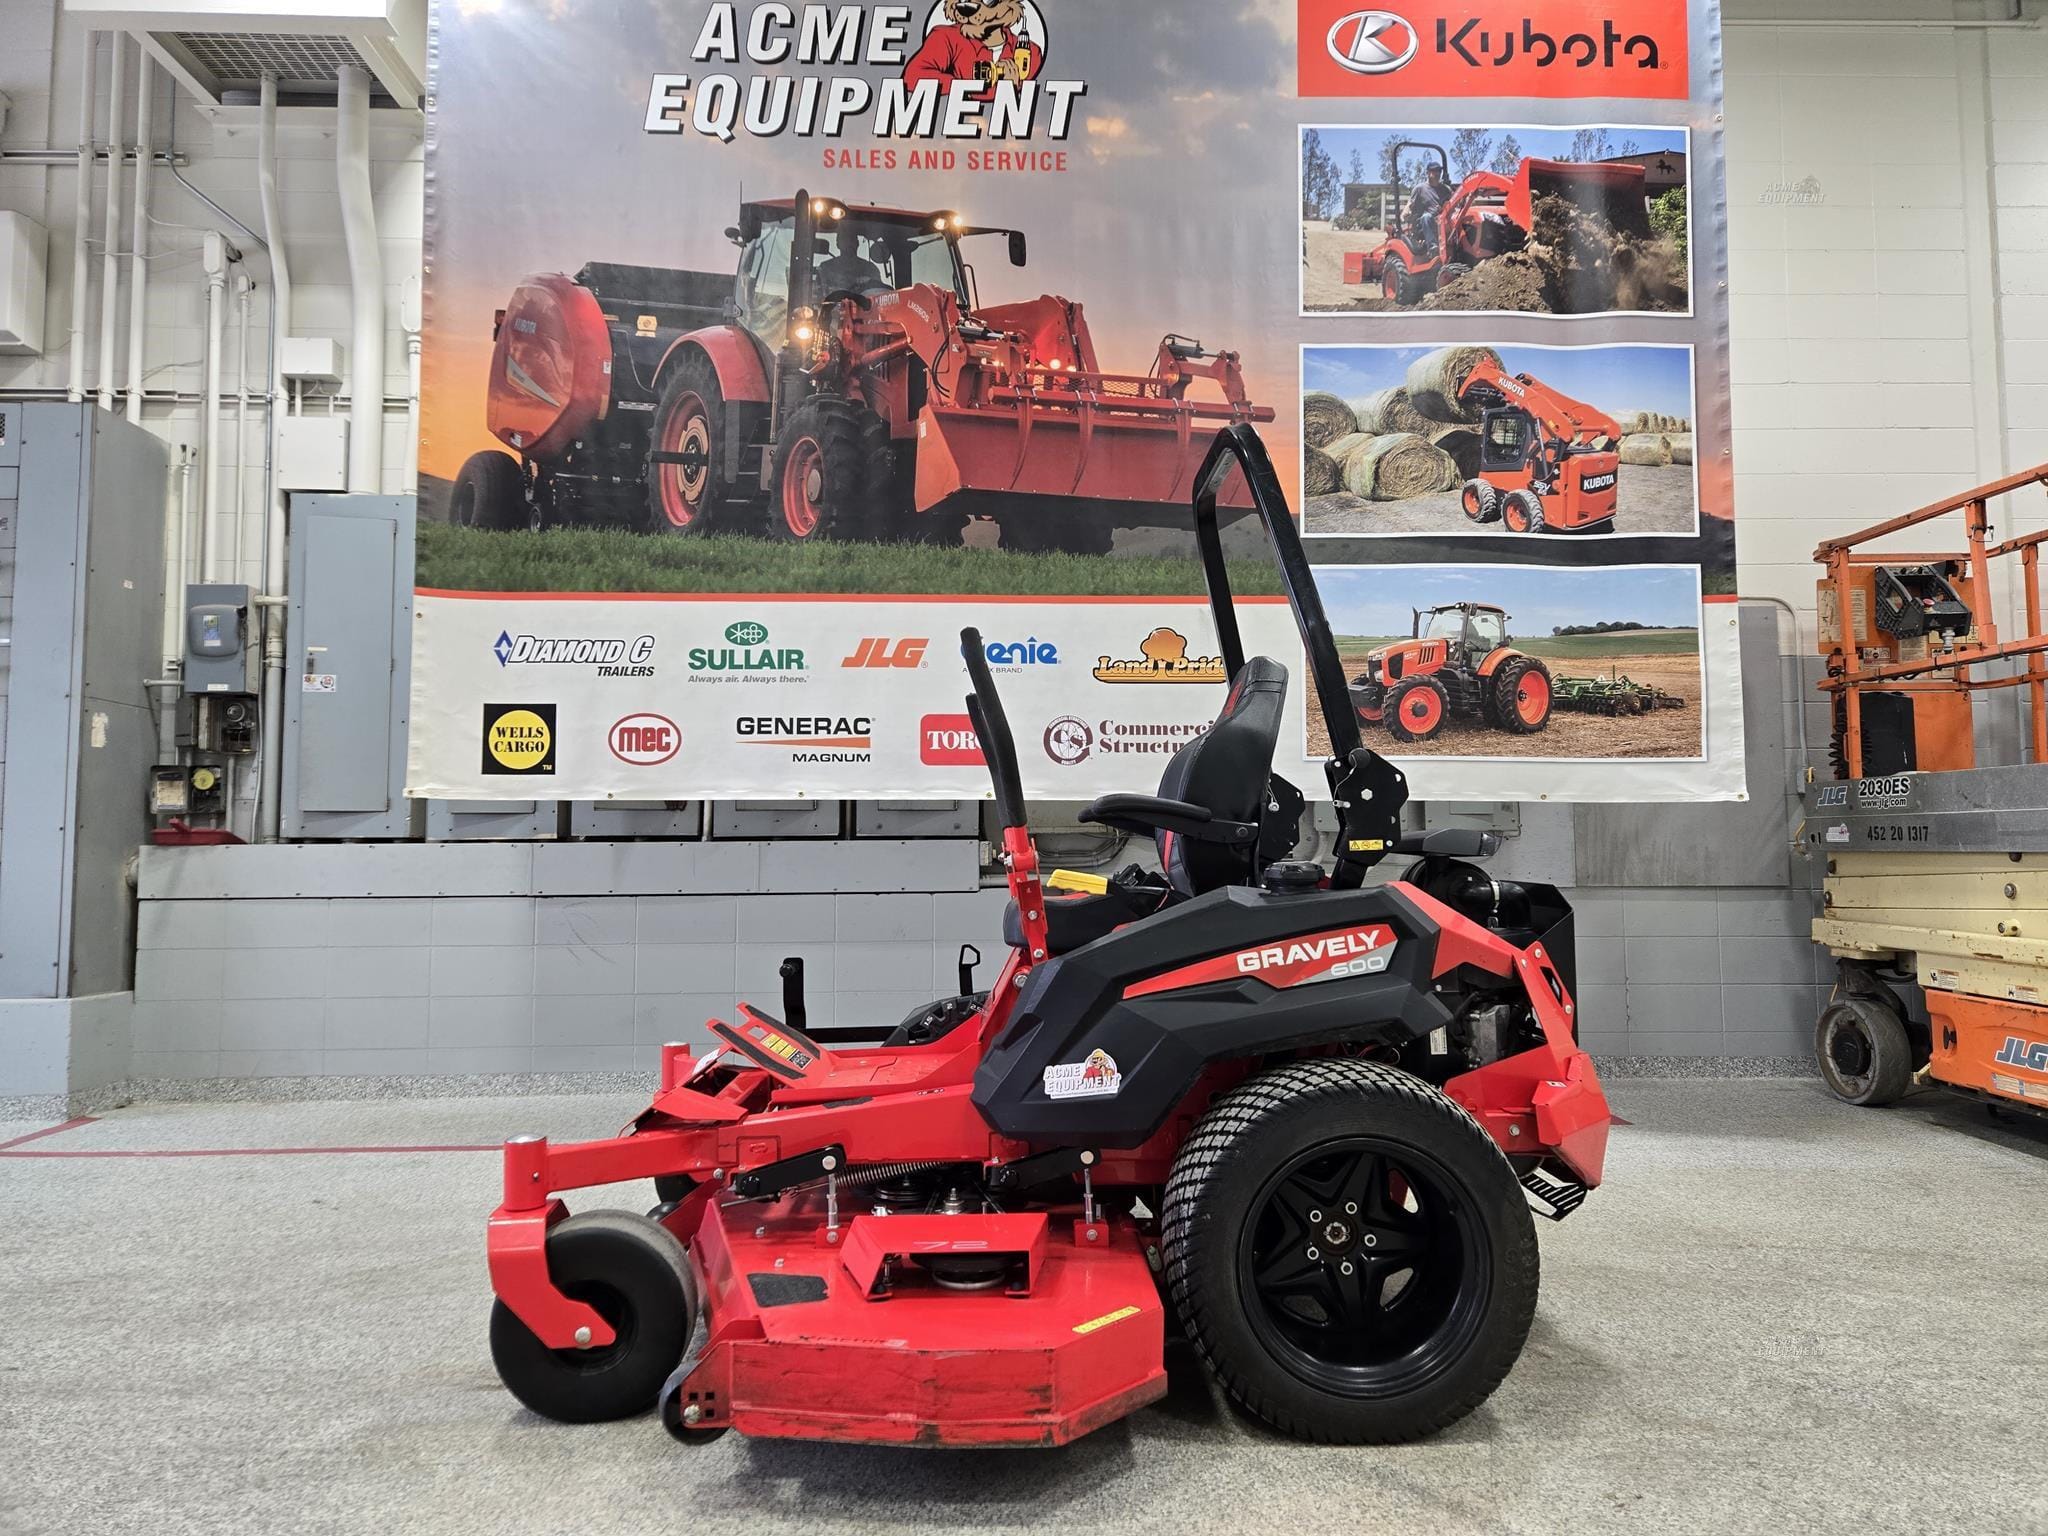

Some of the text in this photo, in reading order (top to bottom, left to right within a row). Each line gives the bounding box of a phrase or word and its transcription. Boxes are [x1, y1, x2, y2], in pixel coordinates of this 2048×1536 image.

[690, 2, 912, 64] ACME
[1436, 18, 1659, 69] Kubota
[643, 73, 1087, 143] EQUIPMENT
[823, 149, 1067, 172] SALES AND SERVICE
[1498, 377, 1525, 398] KUBOTA
[1583, 474, 1614, 490] KUBOTA
[508, 635, 655, 664] DIAMOND C
[688, 648, 804, 670] SULLAIR
[841, 638, 930, 668] JLG
[961, 636, 1058, 664] enie
[597, 666, 655, 677] TRAILERS
[1098, 656, 1155, 675] Land
[688, 675, 807, 684] Always air. Always there.
[495, 727, 544, 738] WELLS
[736, 717, 871, 735] GENERAC
[1099, 720, 1215, 736] Commerci
[494, 741, 544, 753] CARGO
[1099, 738, 1185, 753] Structu
[792, 754, 871, 762] MAGNUM
[1818, 786, 1847, 806] JLG
[1860, 778, 1909, 796] 2030ES
[1861, 798, 1907, 808] www.jlg.com
[1868, 826, 1928, 841] 452 20 1317
[1236, 930, 1380, 972] GRAVELY
[1331, 956, 1385, 976] 600
[1995, 1036, 2048, 1072] JLG
[1045, 1065, 1081, 1079] ACME
[1046, 1074, 1120, 1093] EQUIPMENT
